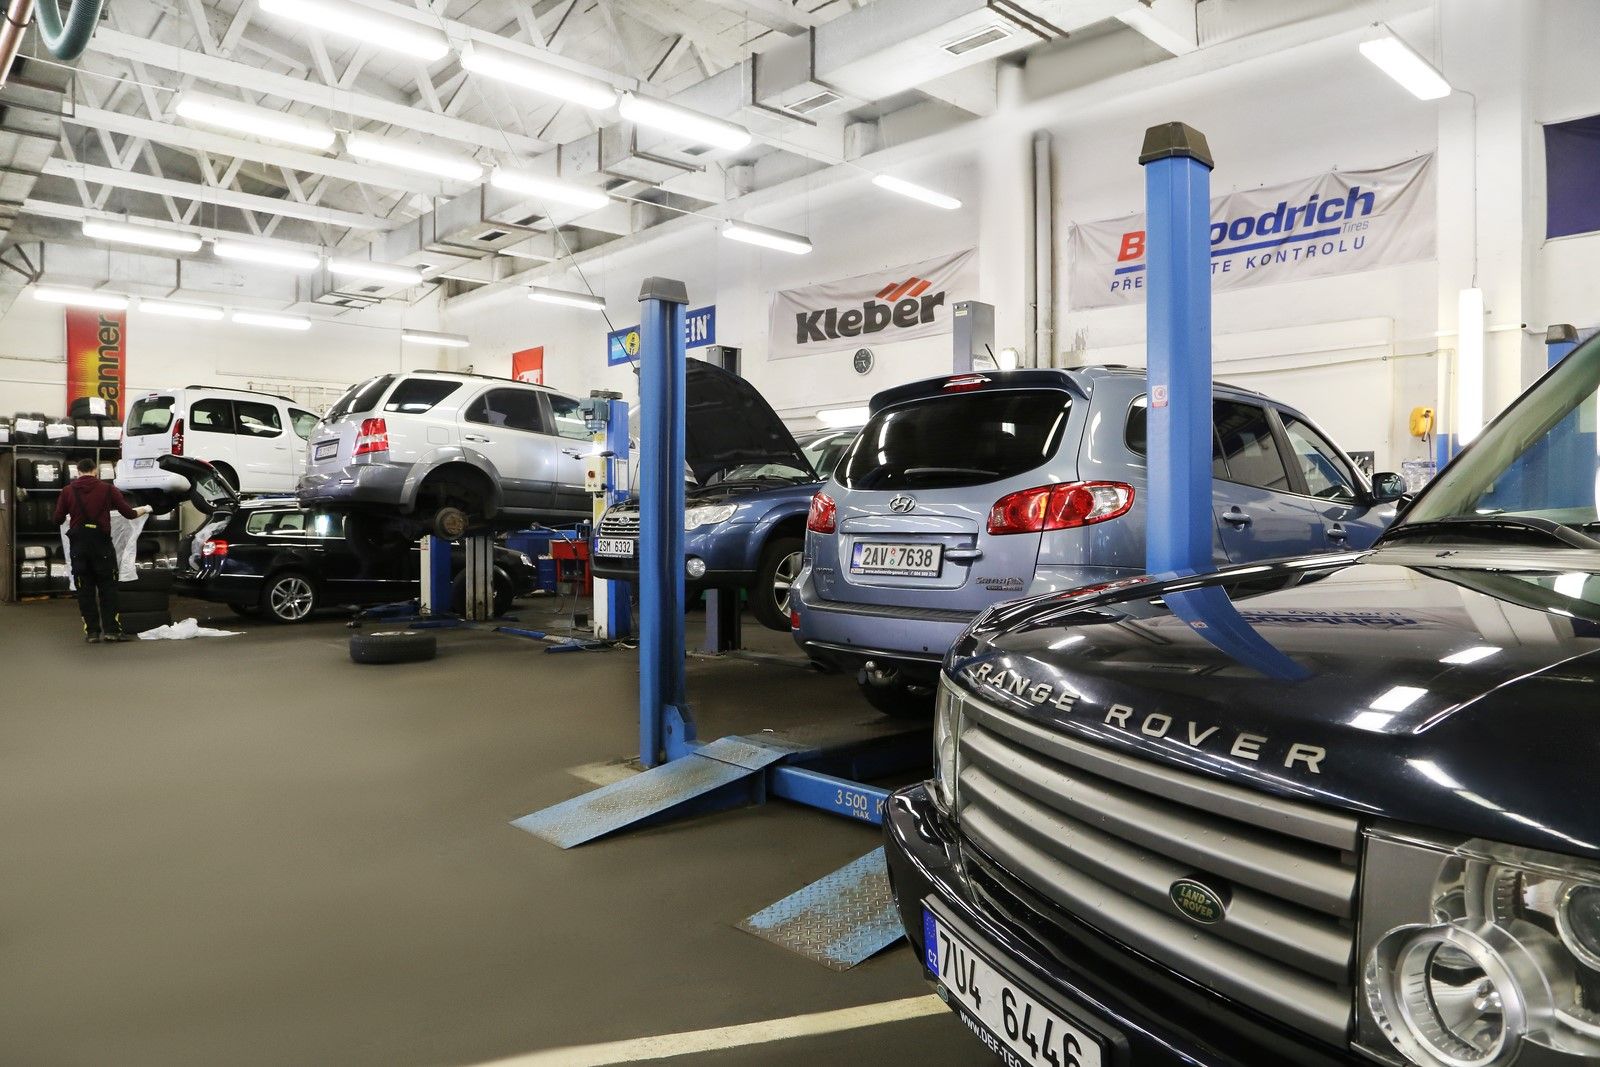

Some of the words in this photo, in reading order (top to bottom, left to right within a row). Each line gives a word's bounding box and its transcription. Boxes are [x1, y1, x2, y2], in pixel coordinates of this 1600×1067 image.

[1117, 186, 1375, 262] Boodrich
[1342, 220, 1369, 234] Tires
[1246, 236, 1365, 269] KONTROLU
[796, 291, 945, 344] Kleber
[615, 541, 630, 553] 6332
[863, 547, 888, 565] 2AV
[897, 548, 933, 567] 7638
[977, 662, 1081, 713] RANGE
[1103, 704, 1327, 774] ROVER
[876, 798, 885, 815] K
[1183, 898, 1213, 918] ROVER
[928, 948, 938, 968] CZ
[940, 930, 982, 1011] 7U4
[1001, 987, 1083, 1067] 6446
